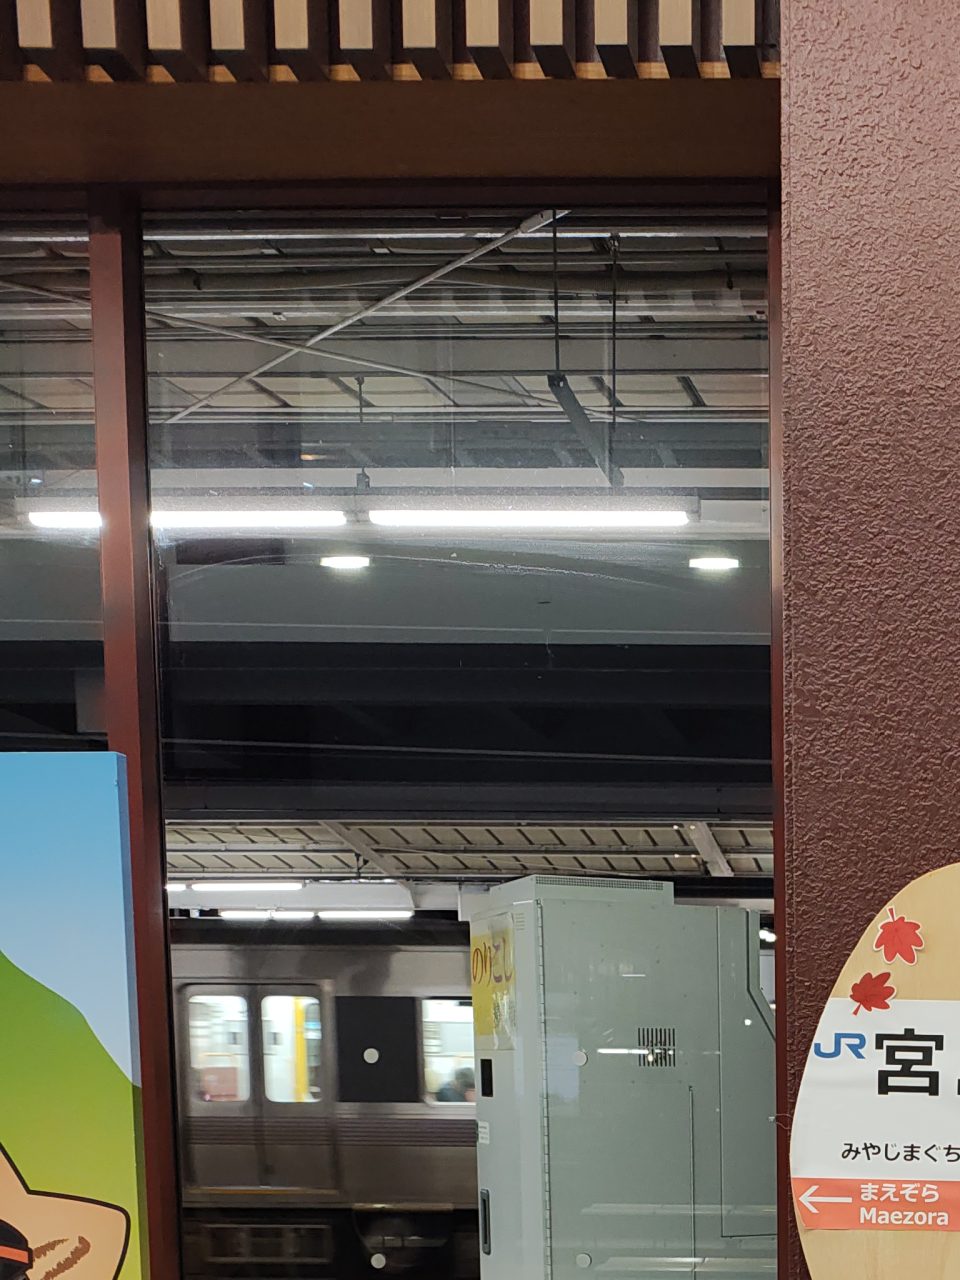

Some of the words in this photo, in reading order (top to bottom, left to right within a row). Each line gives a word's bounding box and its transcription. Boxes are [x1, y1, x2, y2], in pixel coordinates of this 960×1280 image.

[813, 1032, 867, 1060] JR
[860, 1182, 940, 1203] まえぞら
[859, 1207, 949, 1226] Maezora
